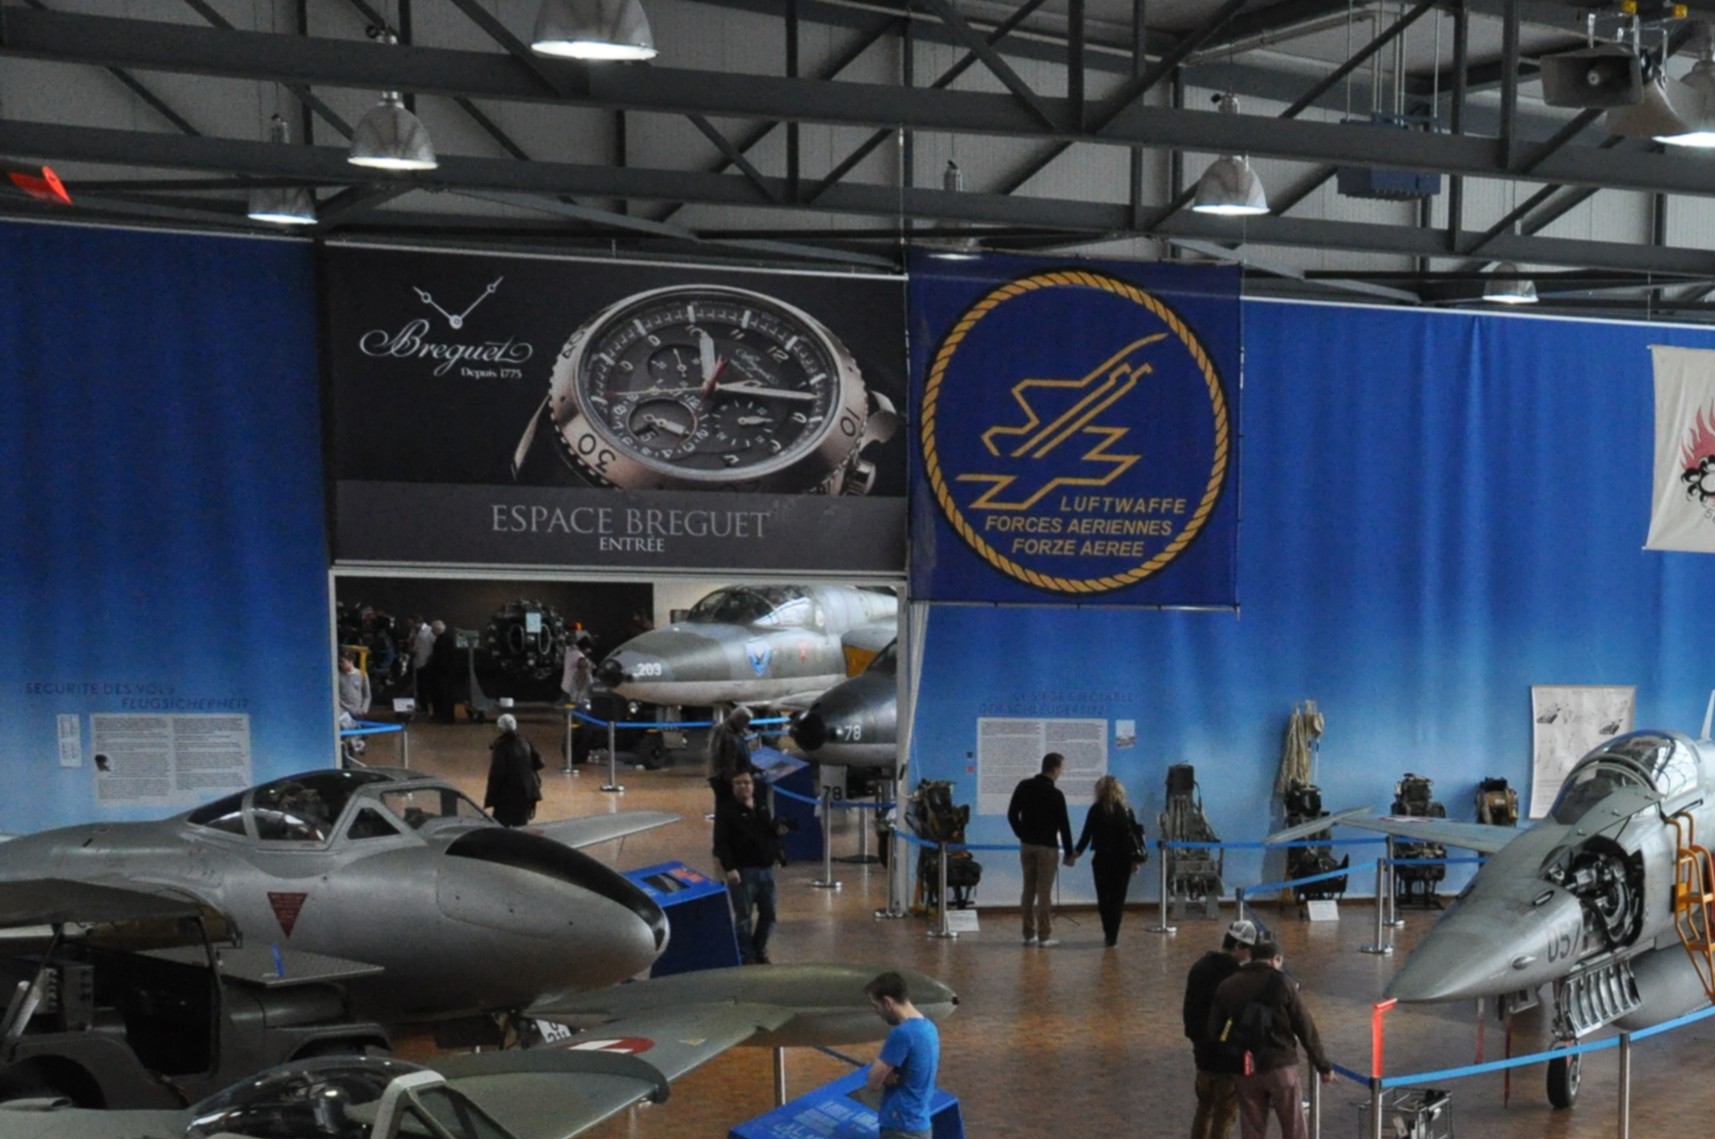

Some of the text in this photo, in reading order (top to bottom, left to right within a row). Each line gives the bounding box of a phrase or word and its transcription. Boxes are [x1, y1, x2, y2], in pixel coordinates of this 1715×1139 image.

[359, 318, 533, 377] Breguet
[461, 367, 523, 379] Depuis 1775
[1060, 495, 1186, 515] LUFTWAFFE
[492, 504, 771, 539] ESPACE BREGUET
[985, 515, 1173, 536] FORCES AERIENNES
[600, 534, 666, 553] ENTRÉE
[1012, 538, 1145, 557] FORZE AEREE
[843, 724, 861, 741] 78
[822, 785, 842, 800] 78
